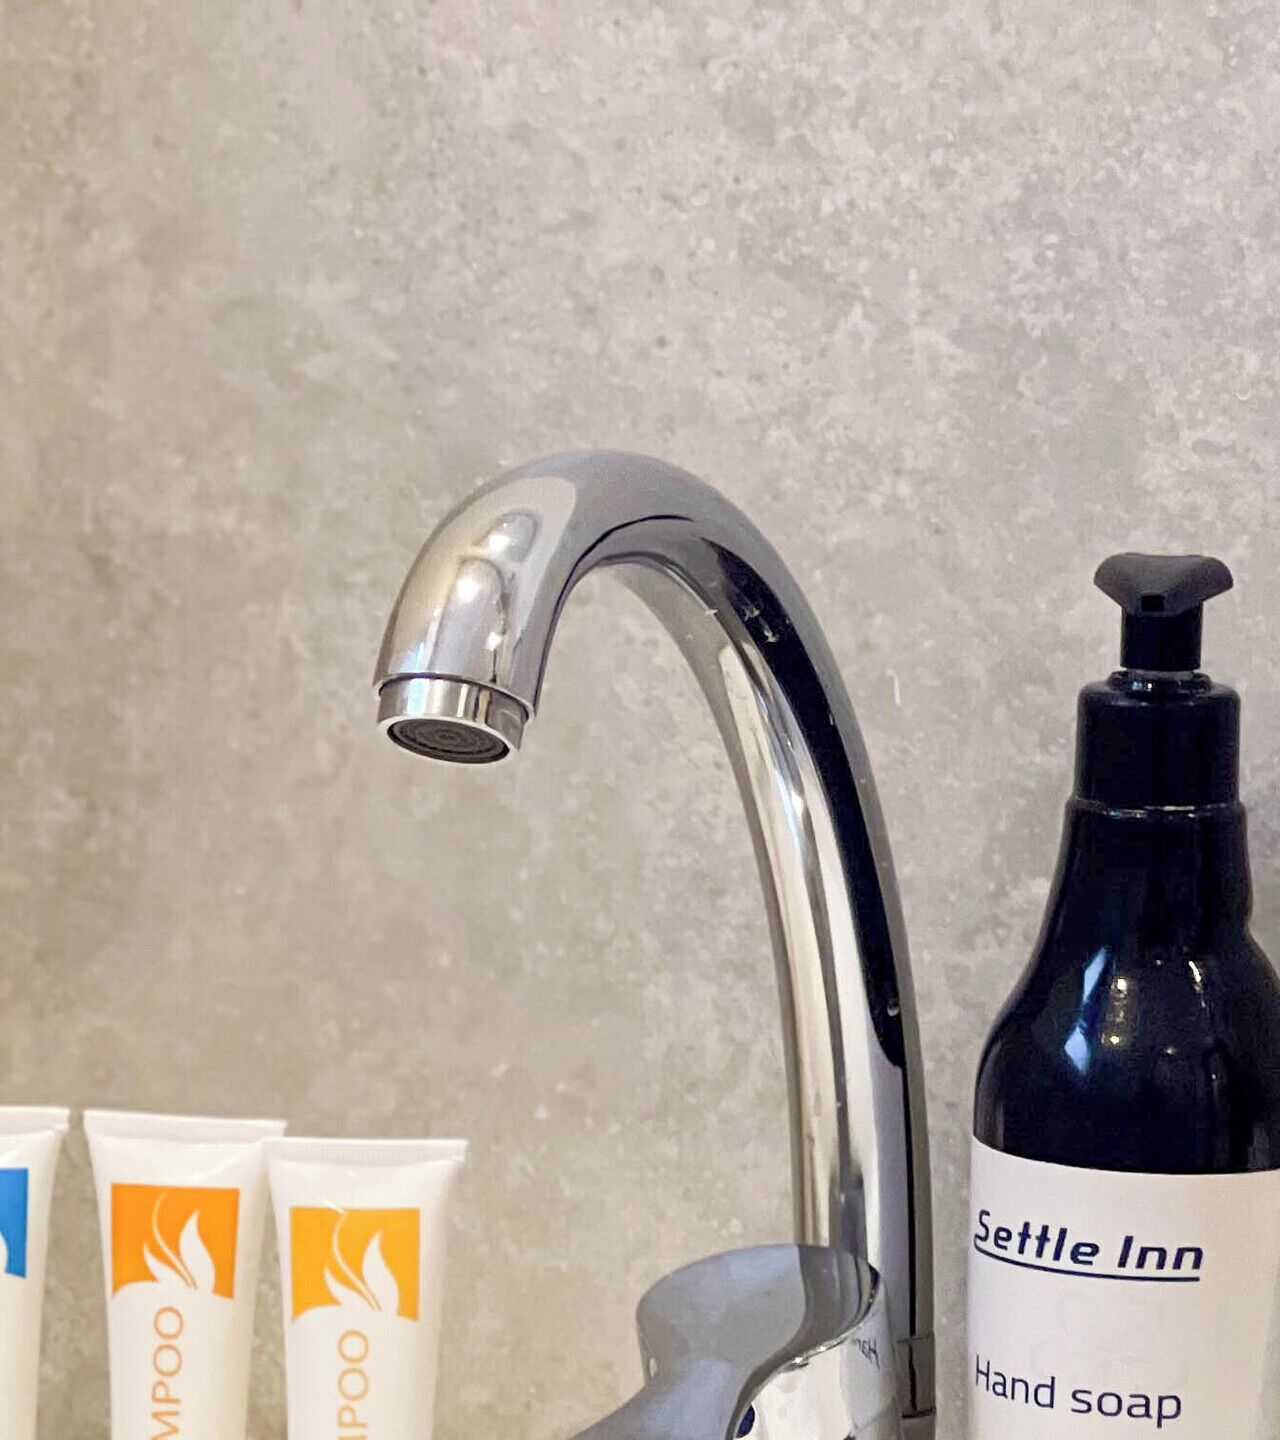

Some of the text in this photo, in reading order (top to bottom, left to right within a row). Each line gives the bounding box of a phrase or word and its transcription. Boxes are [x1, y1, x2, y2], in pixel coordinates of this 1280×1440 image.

[974, 1209, 1203, 1270] Settle Inn
[975, 1355, 1182, 1428] Hand soap
